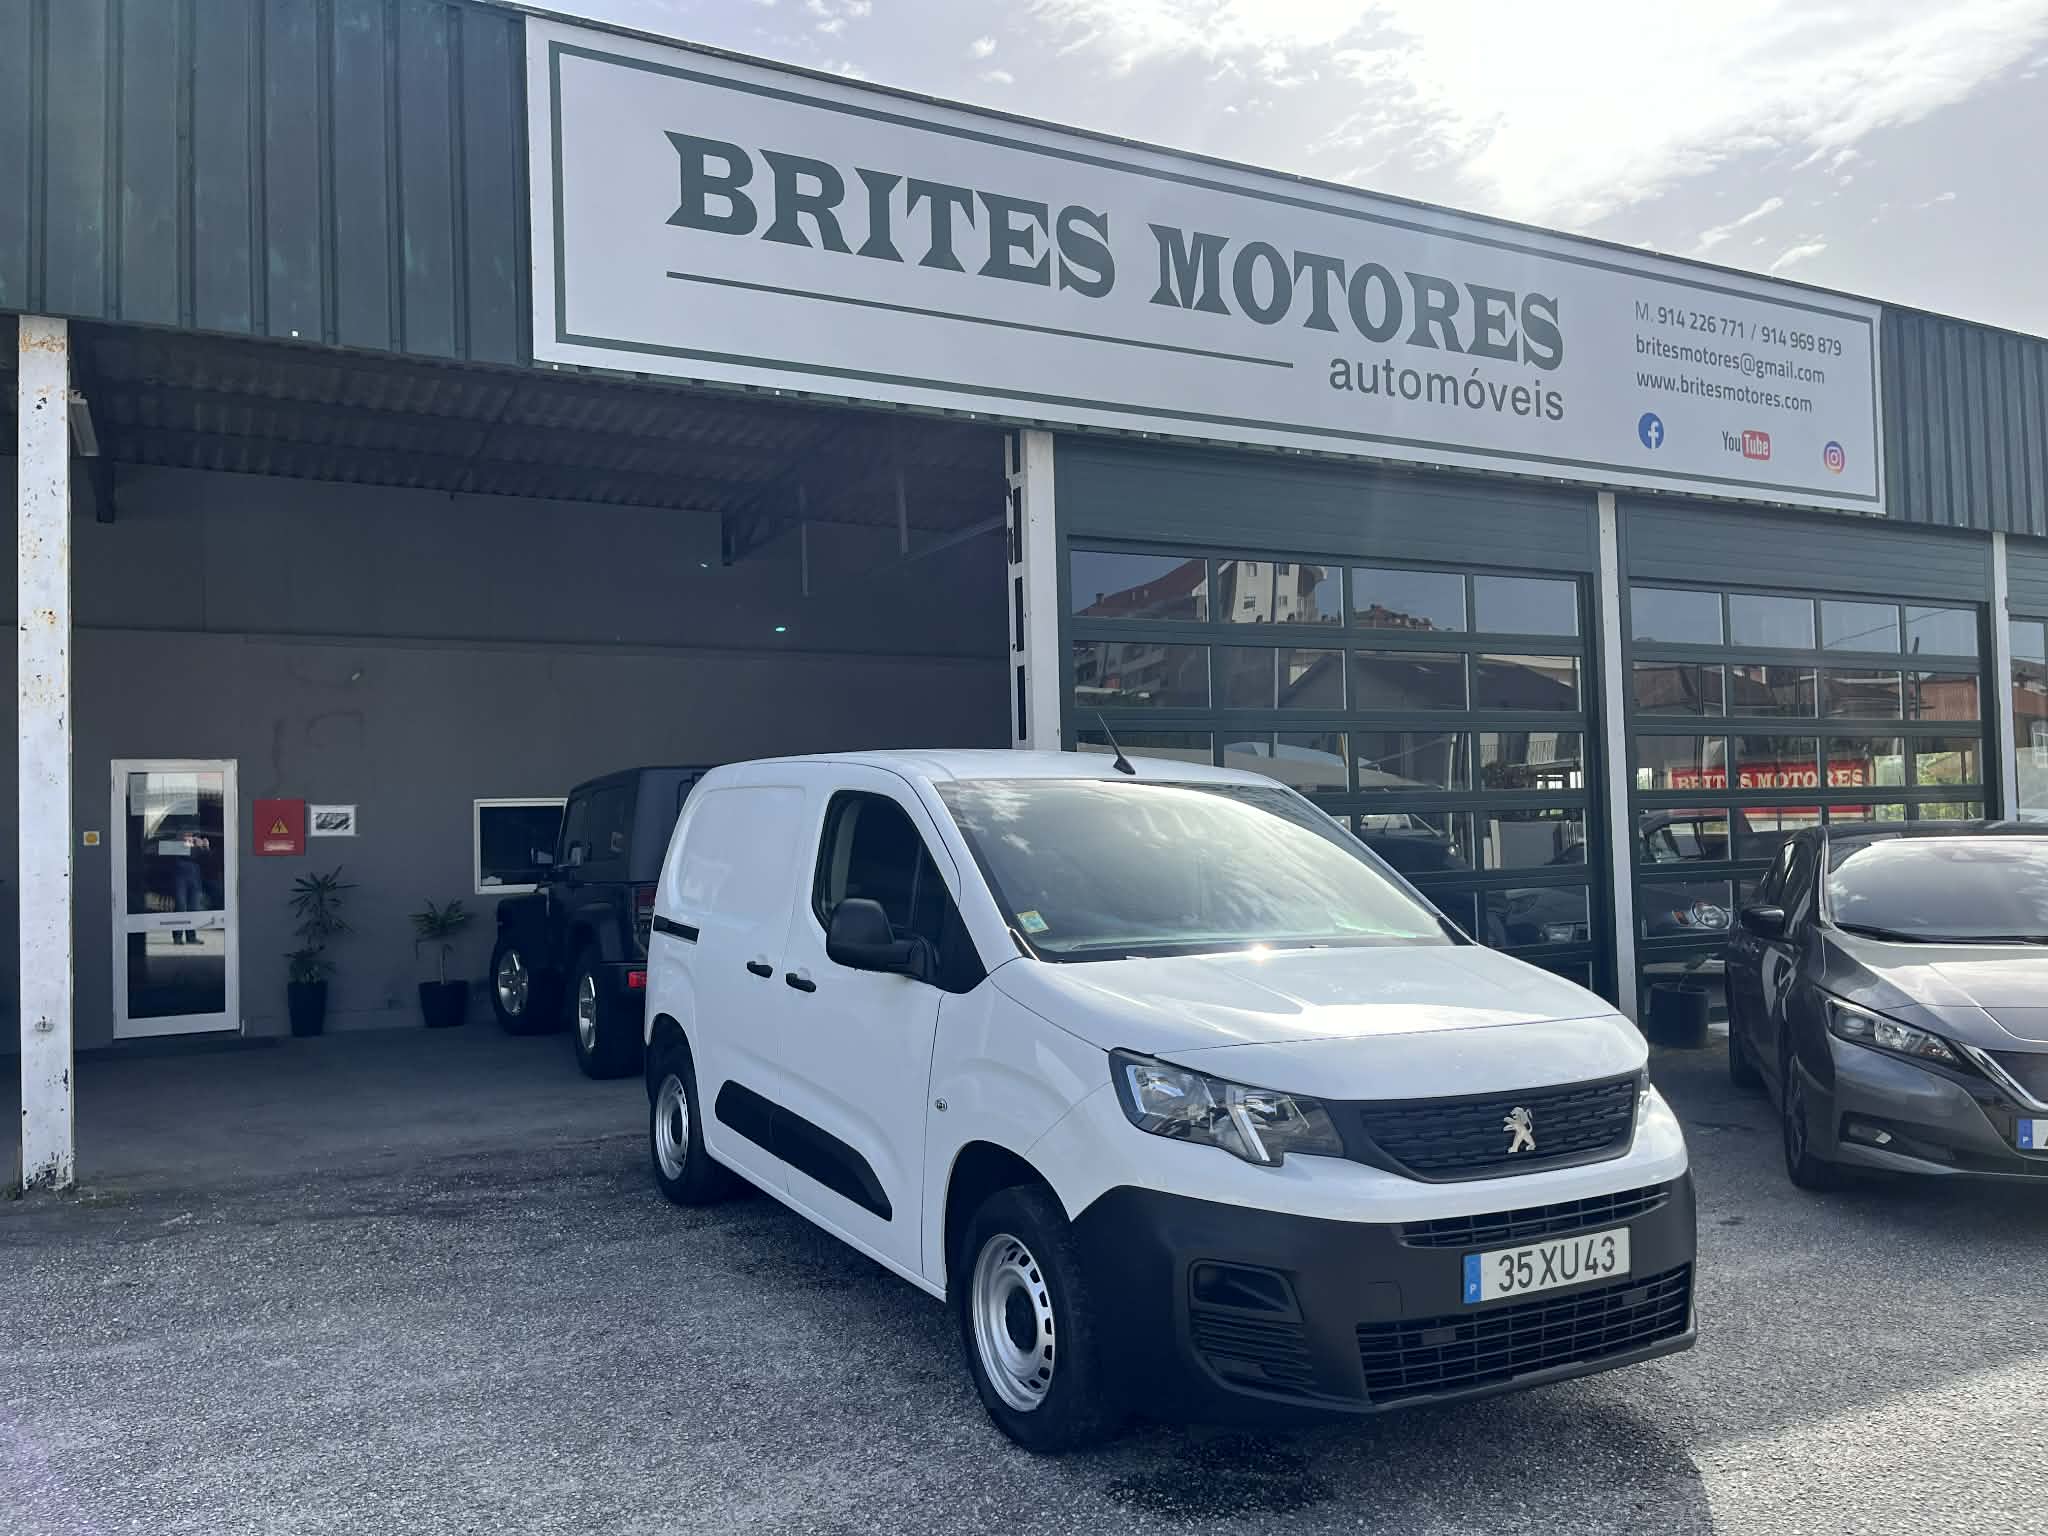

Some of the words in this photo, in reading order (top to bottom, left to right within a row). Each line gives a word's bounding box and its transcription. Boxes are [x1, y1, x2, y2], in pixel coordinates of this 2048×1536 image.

[664, 130, 1116, 298] BRITES
[1148, 223, 1564, 371] MOTORES
[1635, 300, 1654, 322] M.
[1658, 306, 1685, 328] 914
[1689, 312, 1717, 333] 226
[1720, 318, 1744, 339] 771
[1751, 323, 1757, 341] /
[1761, 326, 1786, 346] 914
[1790, 331, 1815, 351] 969
[1818, 337, 1842, 356] 879
[1636, 333, 1825, 384] britesmotores@gmail.com
[1329, 356, 1564, 421] automóveis
[1636, 371, 1813, 413] www.britesmotores.com
[1678, 774, 1753, 789] BRITS
[1469, 1282, 1477, 1295] P
